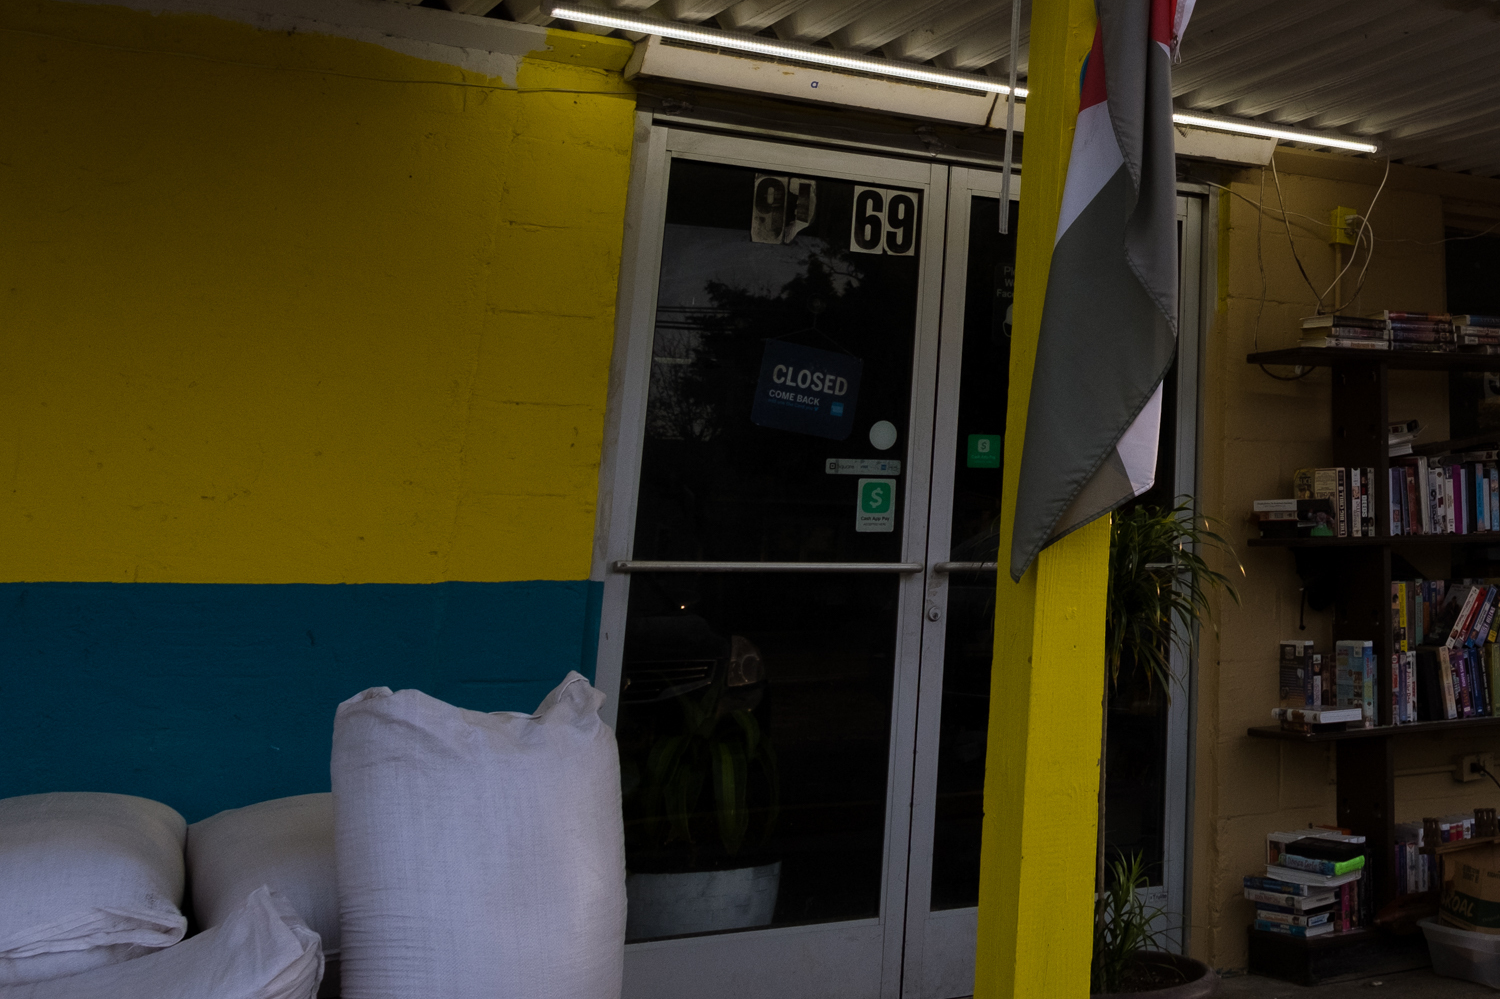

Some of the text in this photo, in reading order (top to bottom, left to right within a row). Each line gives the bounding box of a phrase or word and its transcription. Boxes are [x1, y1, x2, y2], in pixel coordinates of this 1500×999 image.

[854, 189, 915, 254] 69
[772, 364, 848, 396] CLOSED
[769, 389, 820, 406] COME BACK
